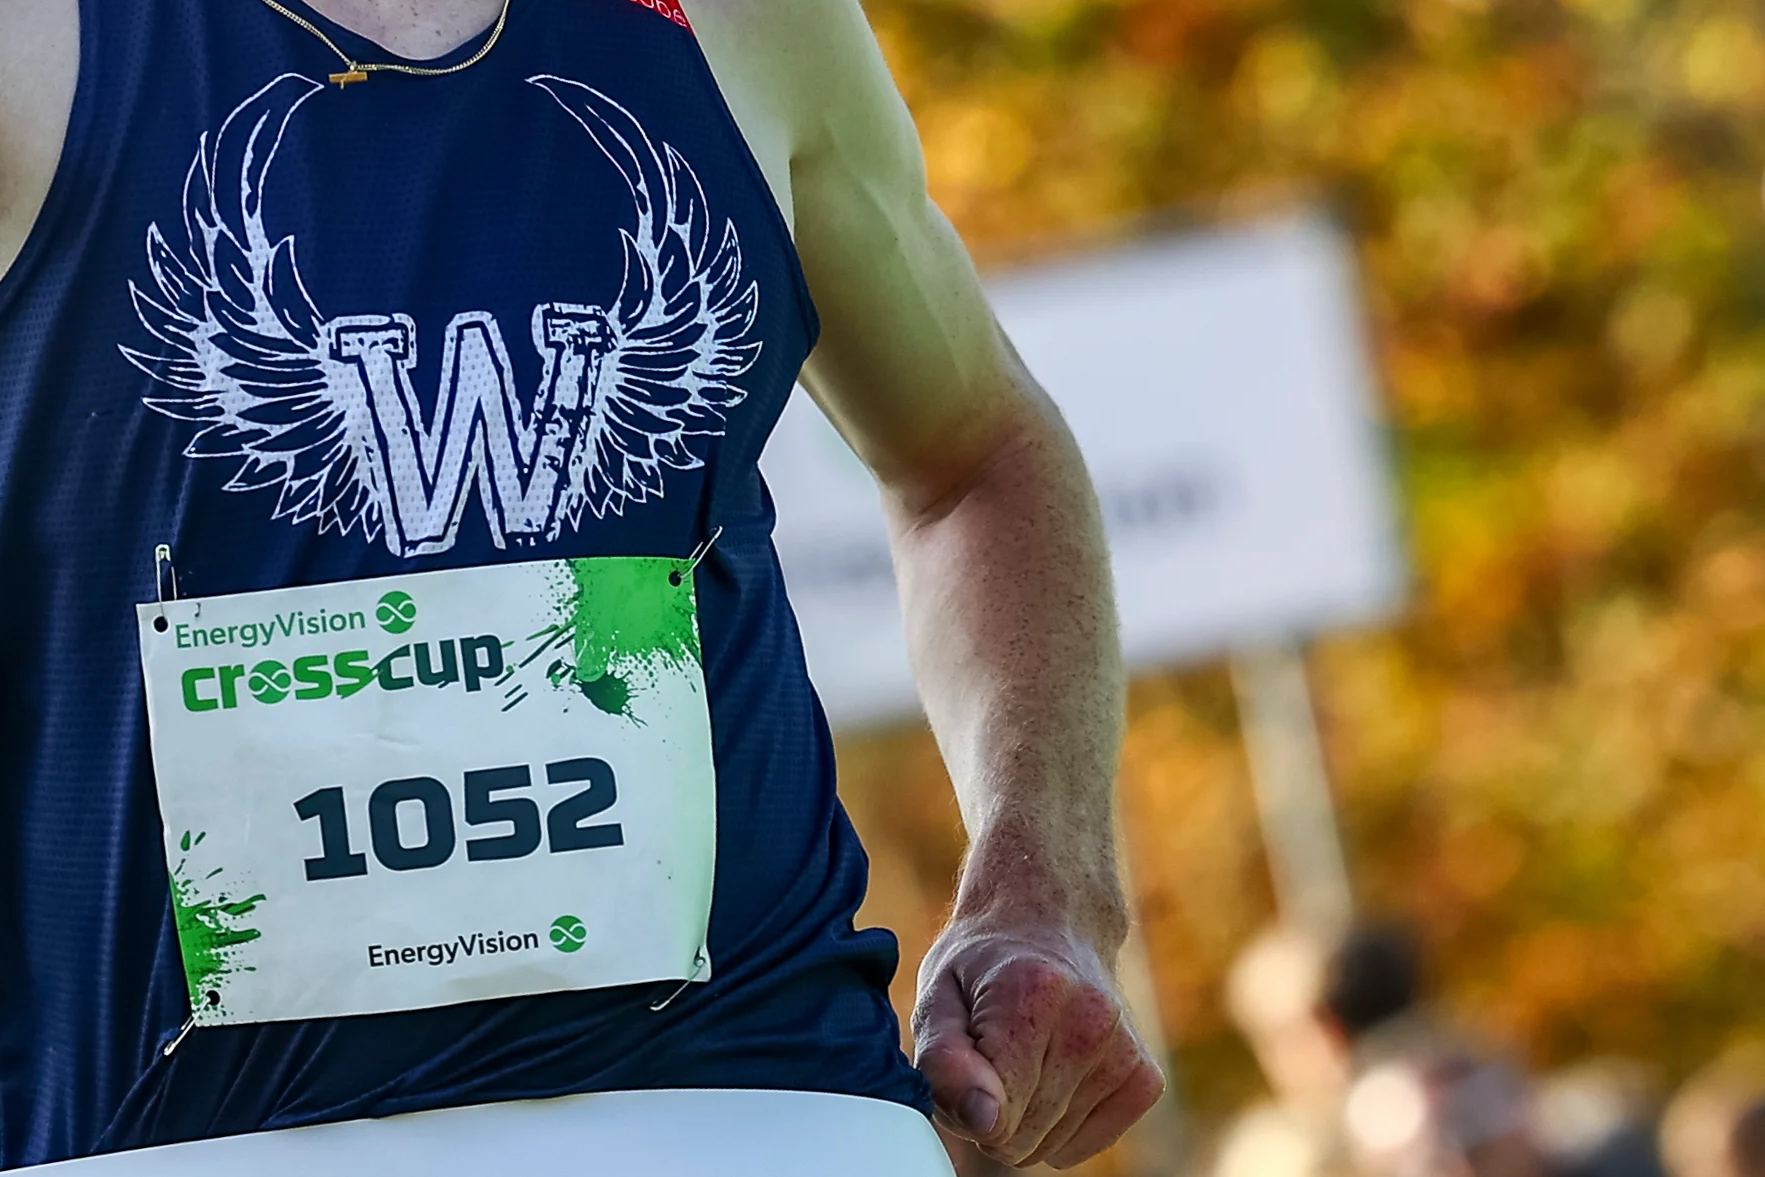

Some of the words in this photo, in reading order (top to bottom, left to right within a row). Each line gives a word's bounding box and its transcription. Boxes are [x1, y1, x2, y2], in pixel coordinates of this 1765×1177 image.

[329, 303, 621, 558] W
[175, 608, 367, 649] EnergyVision
[293, 756, 625, 882] 1052
[367, 930, 540, 968] EnergyVision
